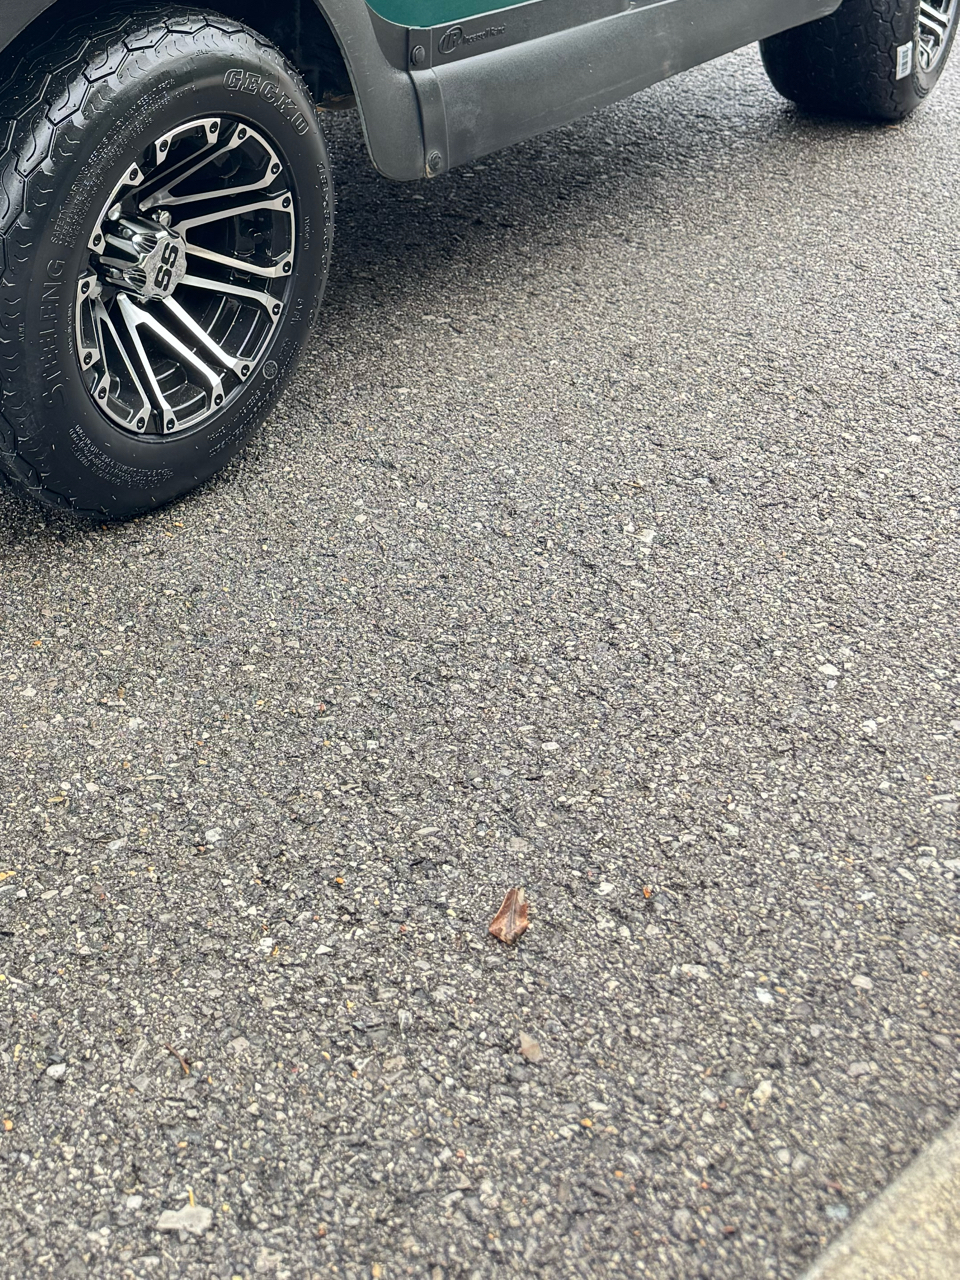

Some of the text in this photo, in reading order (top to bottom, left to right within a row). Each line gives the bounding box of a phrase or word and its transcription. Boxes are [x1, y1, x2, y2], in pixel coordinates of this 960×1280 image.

[222, 68, 309, 136] GECKO
[49, 206, 69, 243] SAFETY
[154, 241, 179, 292] SS
[38, 259, 69, 410] STEELENG
